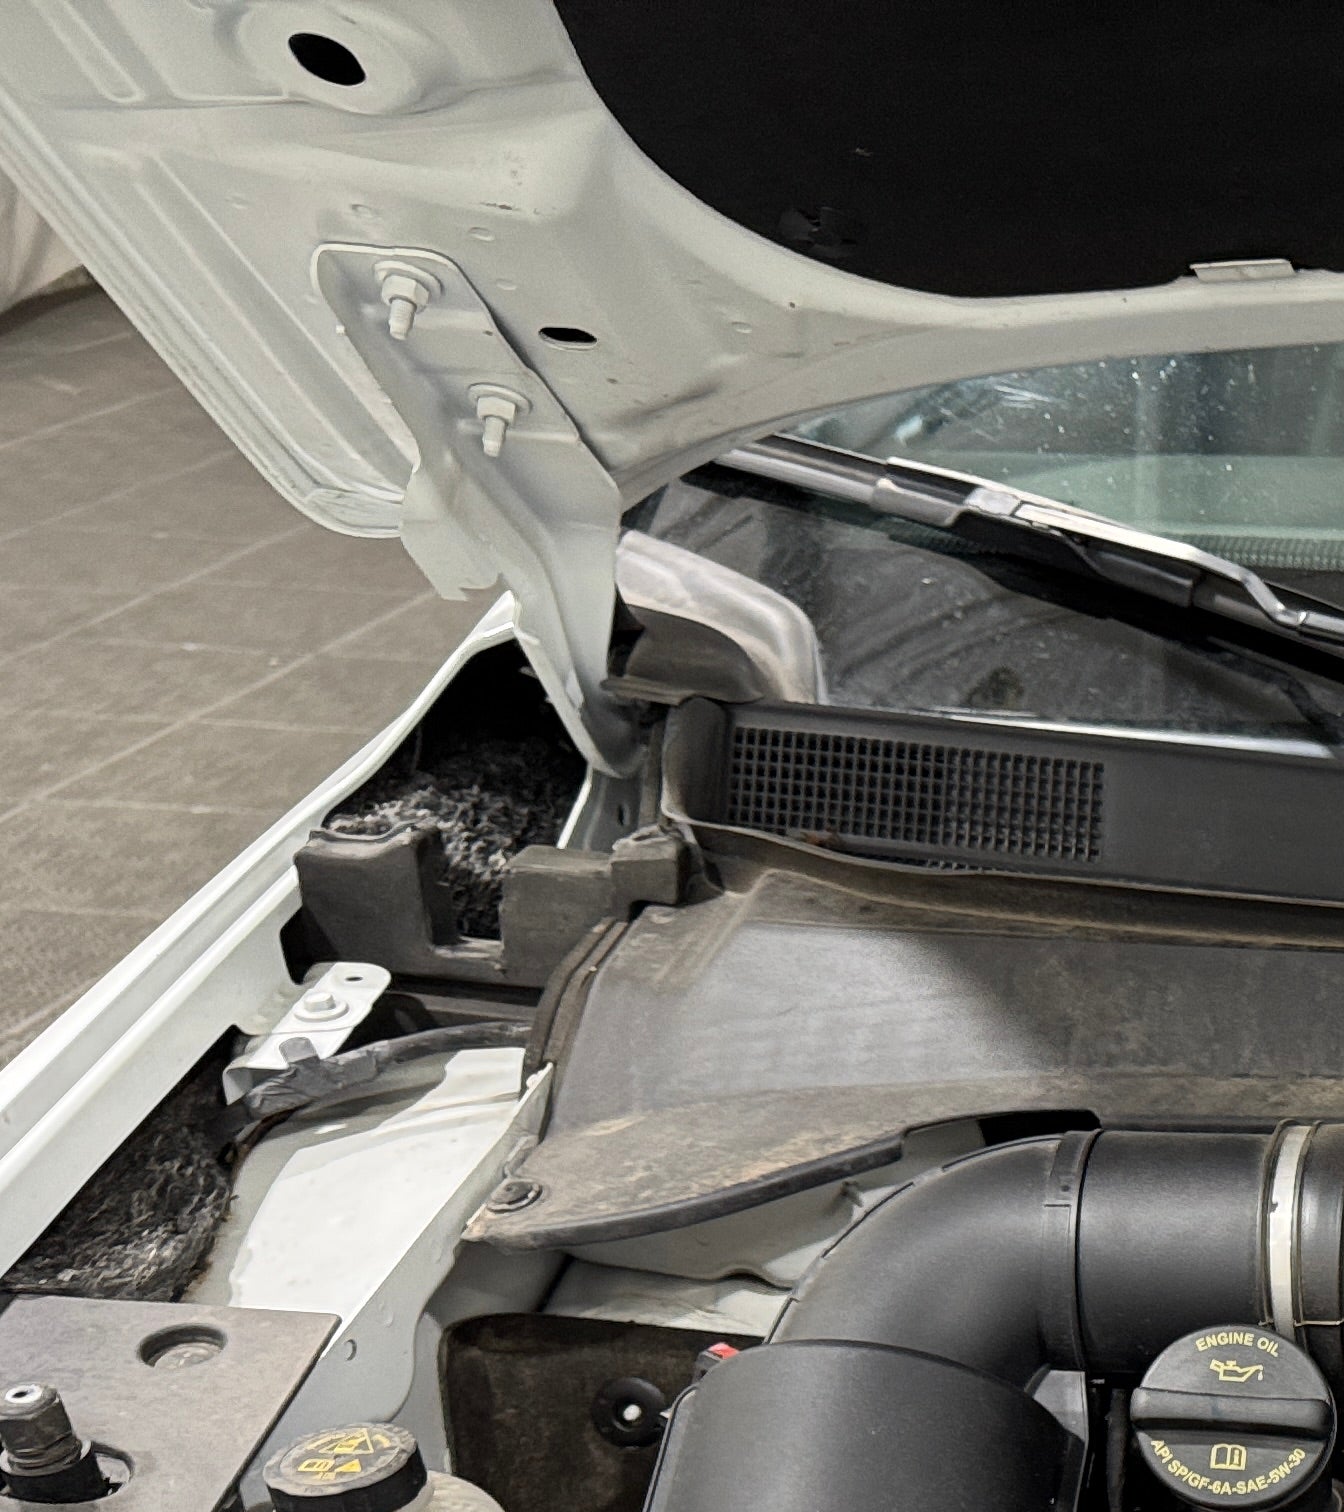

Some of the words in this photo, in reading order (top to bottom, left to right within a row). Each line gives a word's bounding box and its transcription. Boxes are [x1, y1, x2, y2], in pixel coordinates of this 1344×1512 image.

[1195, 1331, 1254, 1353] ENGINE
[1256, 1336, 1280, 1358] OIL
[1150, 1439, 1174, 1465] API
